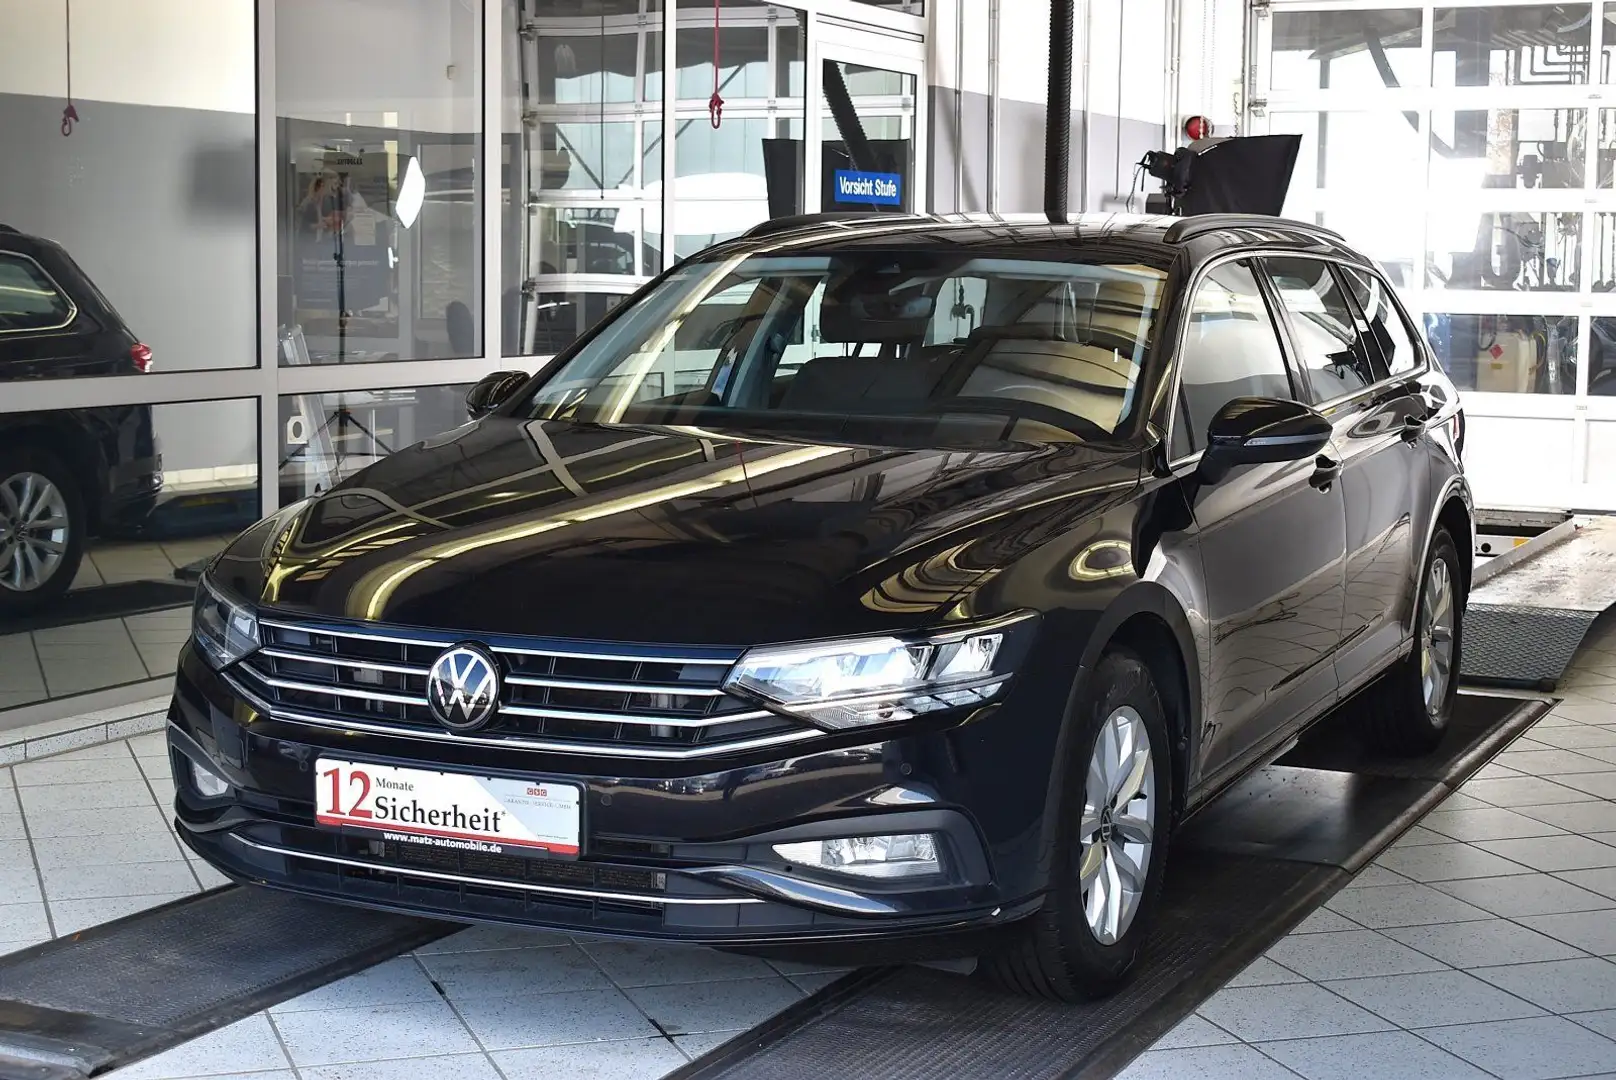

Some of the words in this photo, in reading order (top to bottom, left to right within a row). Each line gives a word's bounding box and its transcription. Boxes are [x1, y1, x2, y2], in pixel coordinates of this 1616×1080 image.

[839, 176, 873, 196] Vorsicht
[874, 178, 897, 197] Stufe
[323, 767, 373, 819] 12
[375, 777, 414, 792] Monate
[383, 832, 502, 853] www.matz-automobile.de
